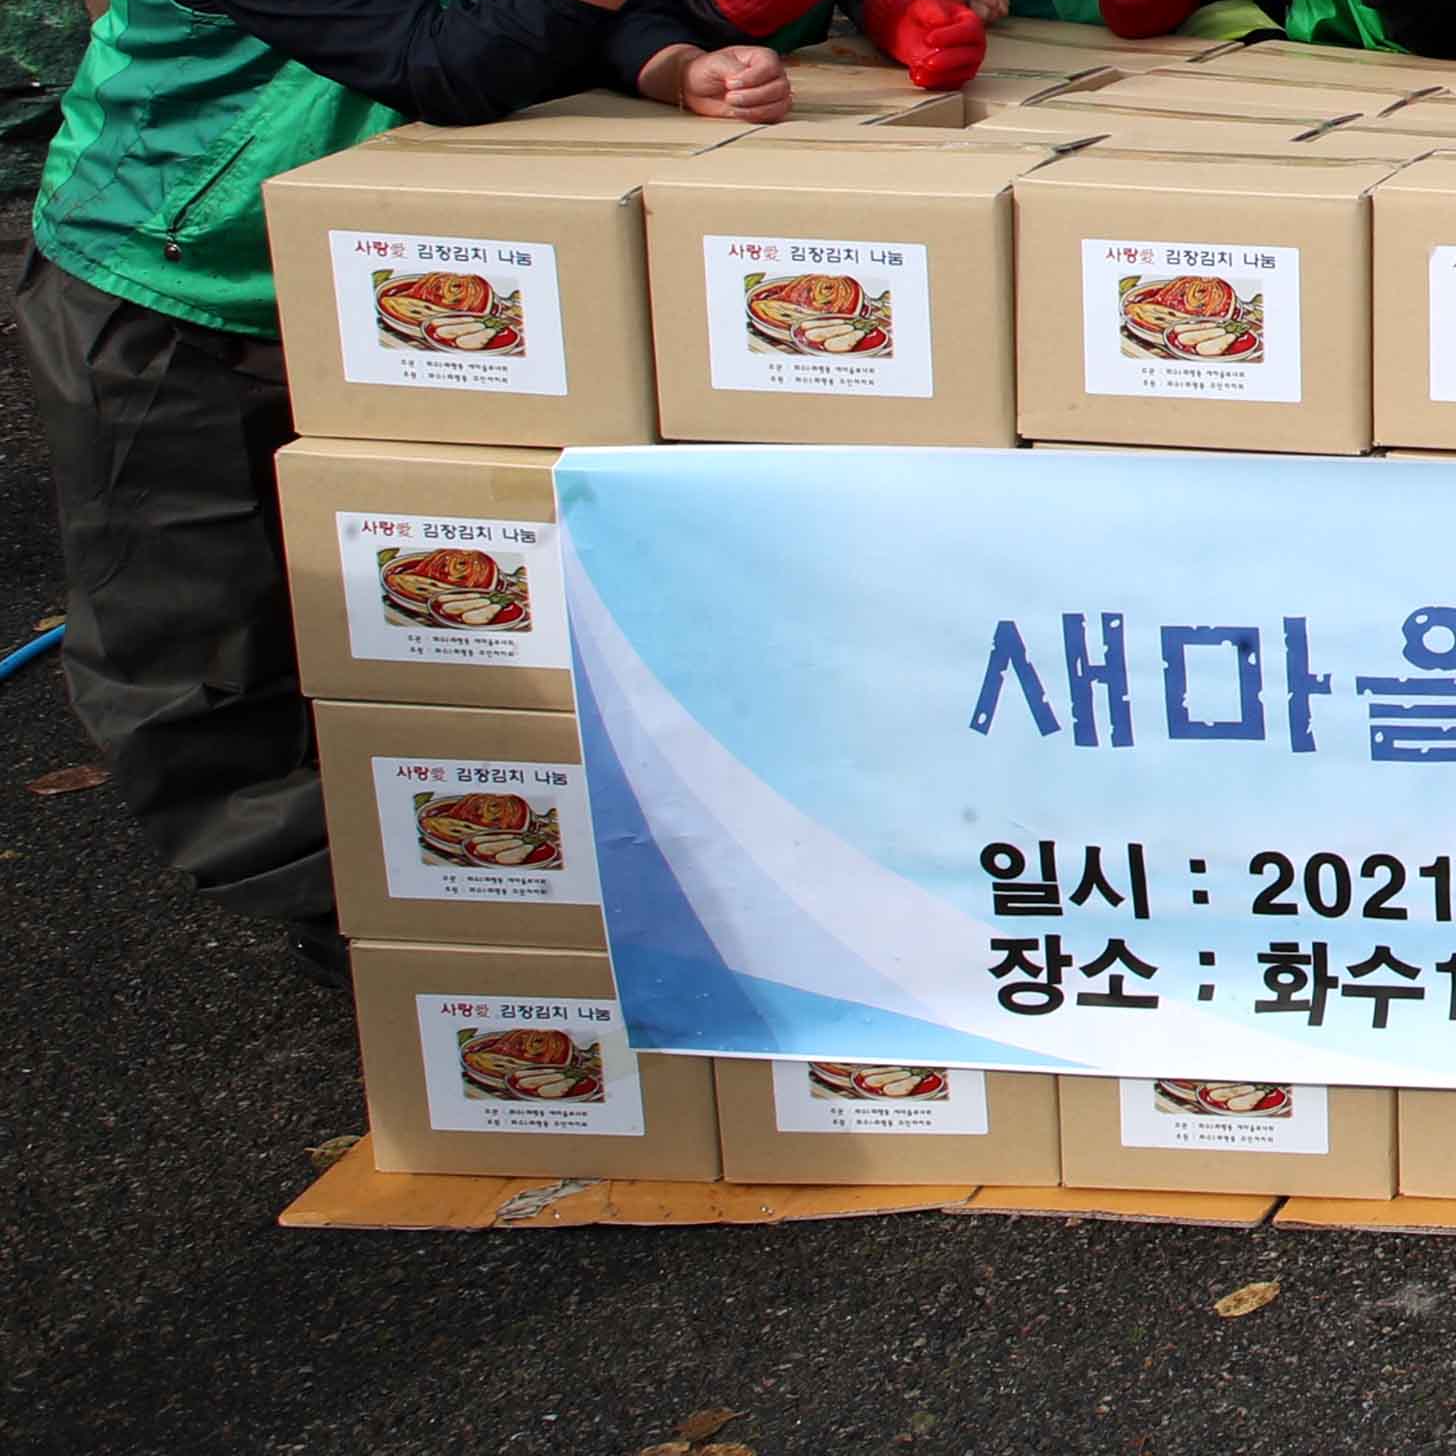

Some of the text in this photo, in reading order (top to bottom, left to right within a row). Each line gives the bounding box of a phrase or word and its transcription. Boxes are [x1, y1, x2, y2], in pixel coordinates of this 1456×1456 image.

[417, 244, 487, 263] 김장김치
[498, 249, 532, 266] 나눔
[790, 246, 859, 264] 김장김치
[870, 250, 903, 266] 나눔
[1166, 249, 1232, 267] 김장김치
[1243, 253, 1275, 269] 나눔
[423, 523, 492, 542] 김장김치
[502, 527, 536, 544] 나눔
[456, 767, 524, 784] 김장김치
[535, 770, 568, 786] 나눔
[979, 841, 1150, 919] 일시
[988, 938, 1160, 1018] 장소
[501, 1004, 568, 1021] 김장김치
[578, 1007, 611, 1022] 나눔
